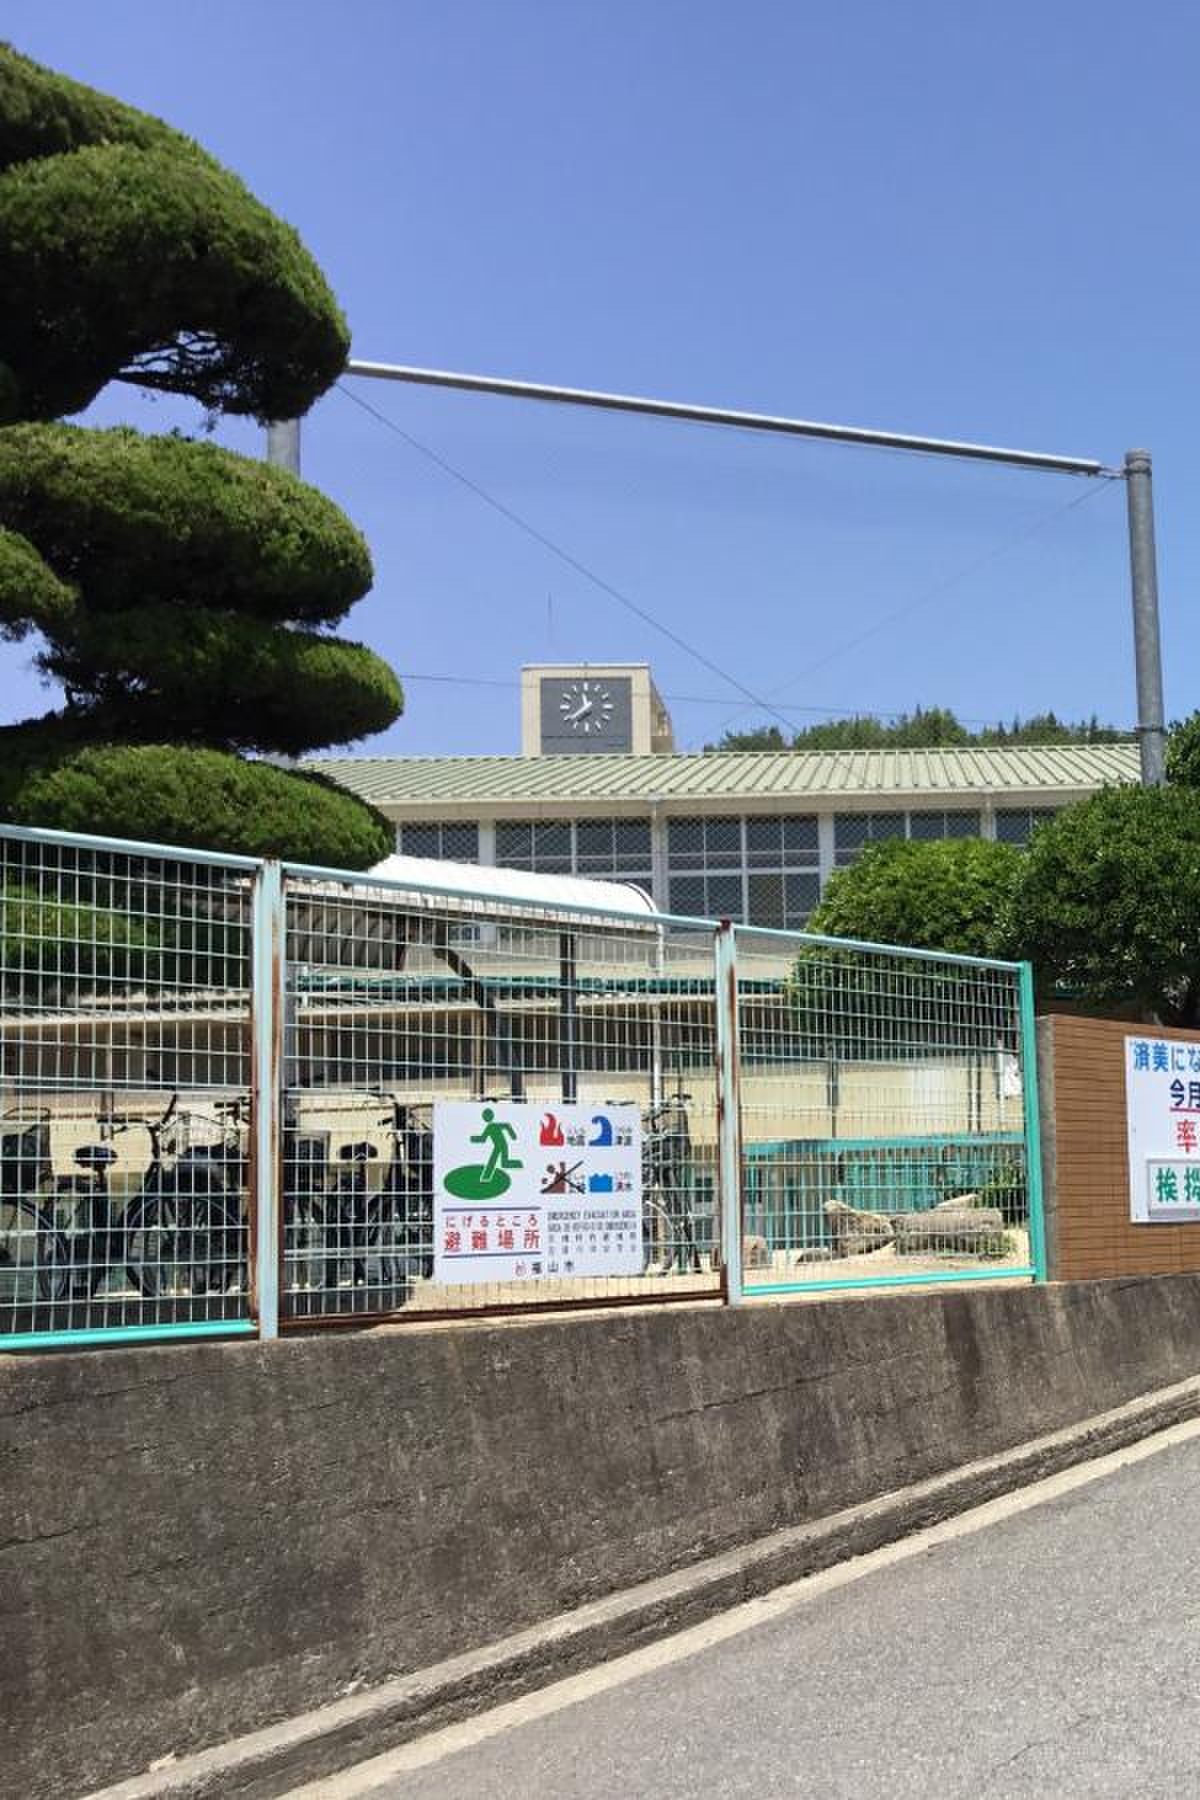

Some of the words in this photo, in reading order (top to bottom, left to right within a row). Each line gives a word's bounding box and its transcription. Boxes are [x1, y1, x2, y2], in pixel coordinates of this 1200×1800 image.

[445, 1214, 538, 1228] にげるところ
[444, 1228, 541, 1252] 避難場所
[531, 1260, 576, 1275] 福山市
